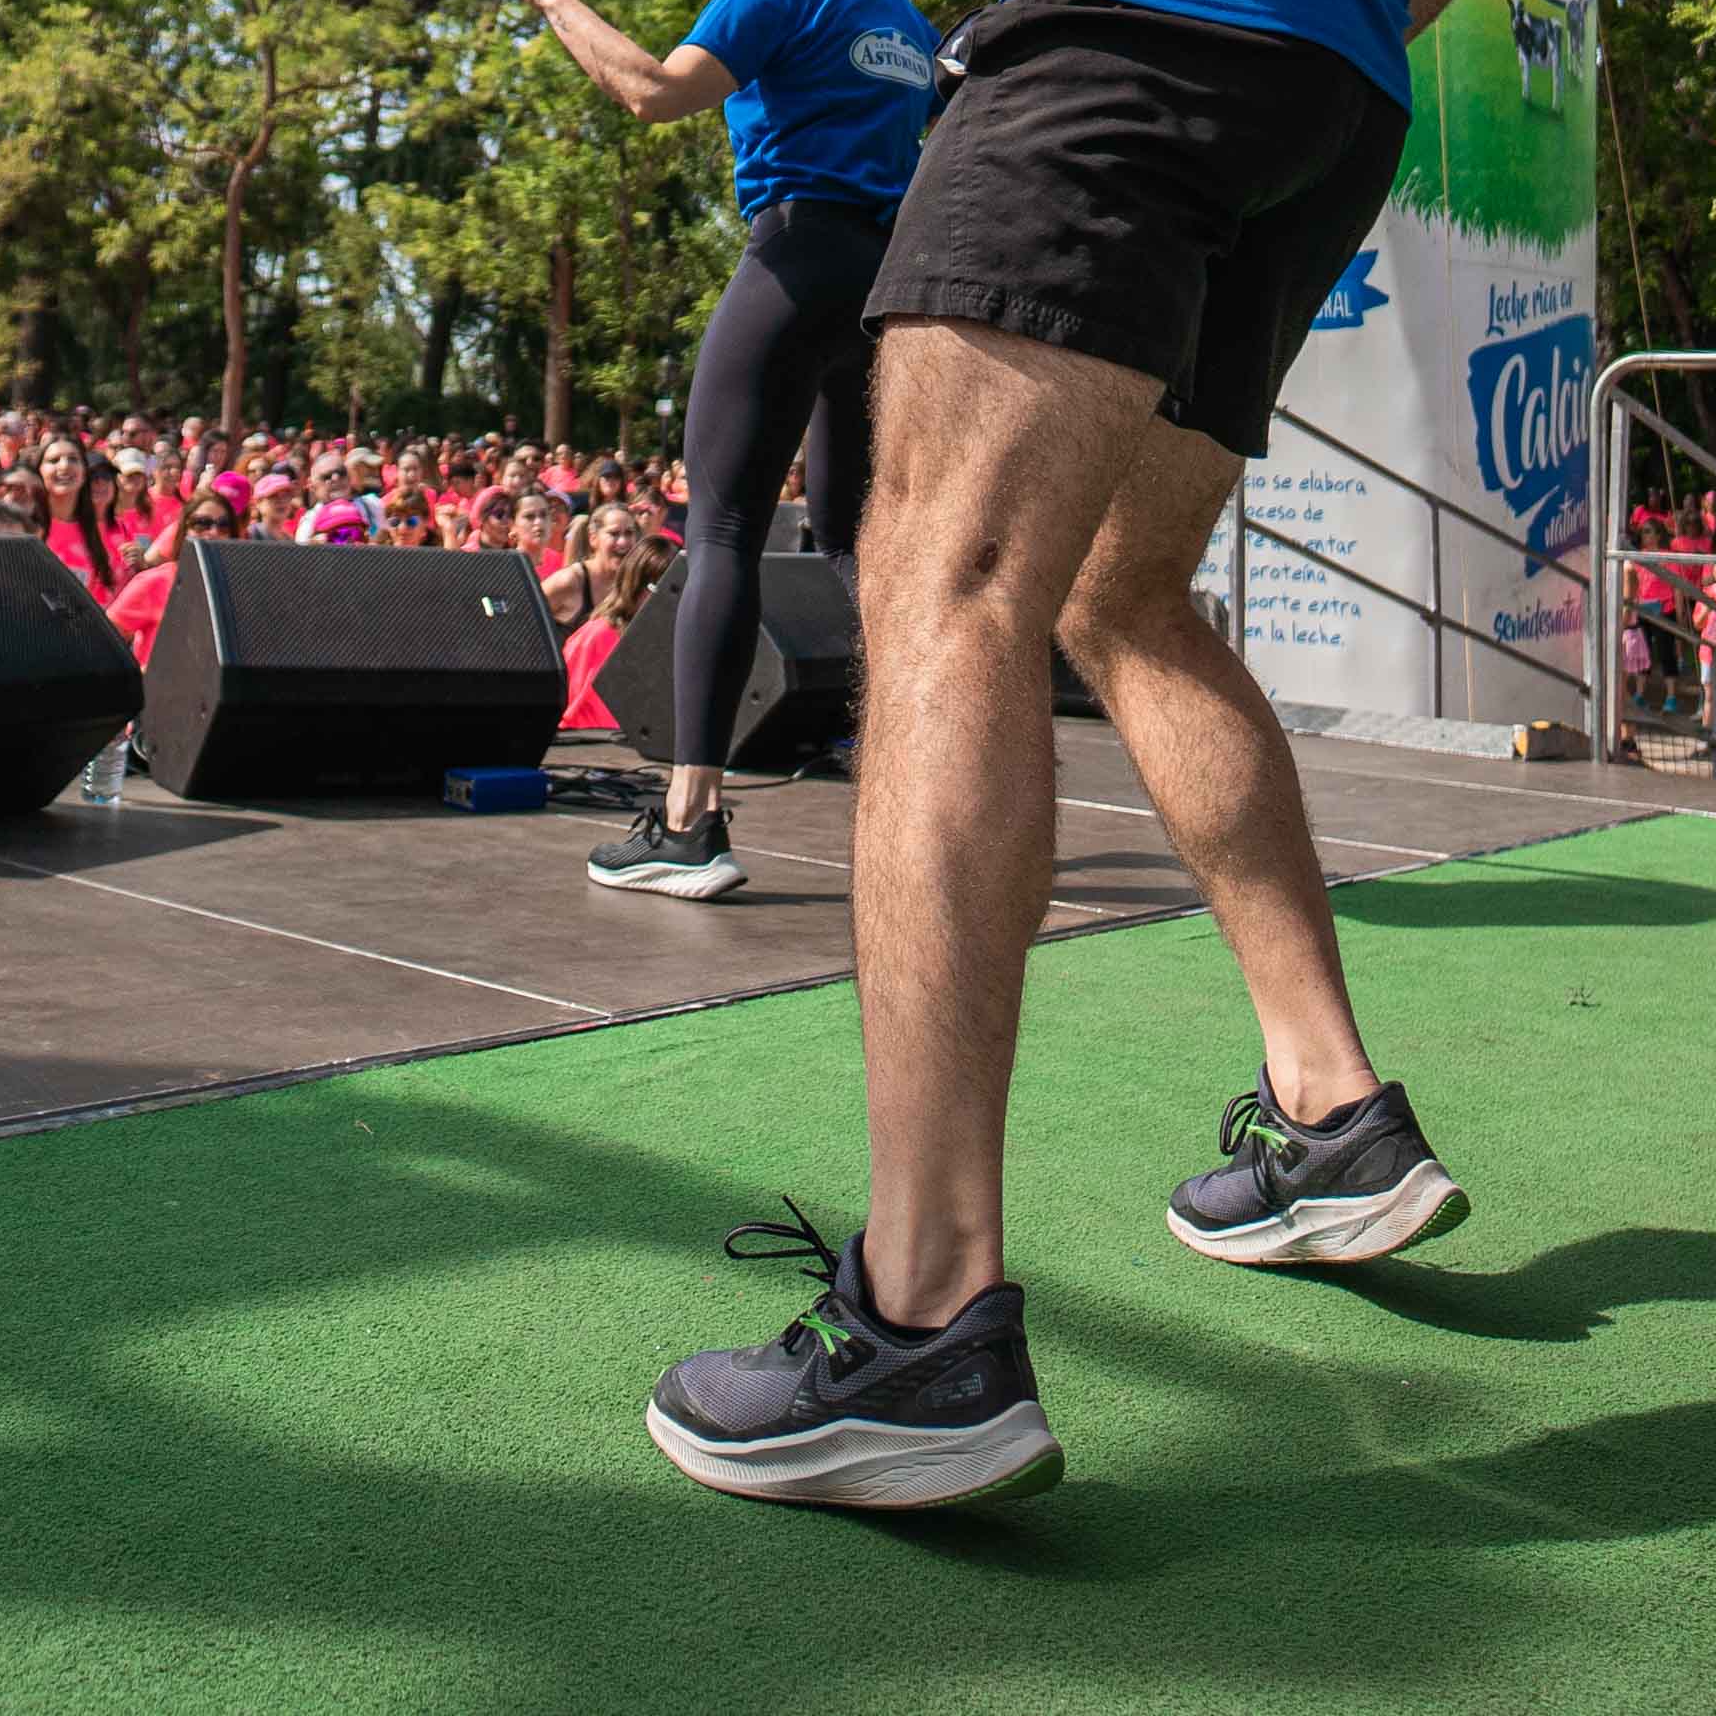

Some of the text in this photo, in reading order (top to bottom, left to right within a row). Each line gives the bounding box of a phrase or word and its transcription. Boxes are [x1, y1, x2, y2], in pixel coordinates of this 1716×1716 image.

[1485, 281, 1529, 339] Leche
[1531, 285, 1557, 318] rica
[1272, 474, 1292, 490] se
[1298, 468, 1367, 496] elabora
[1303, 500, 1325, 522] de
[1308, 598, 1362, 620] extra
[1270, 620, 1285, 643] la
